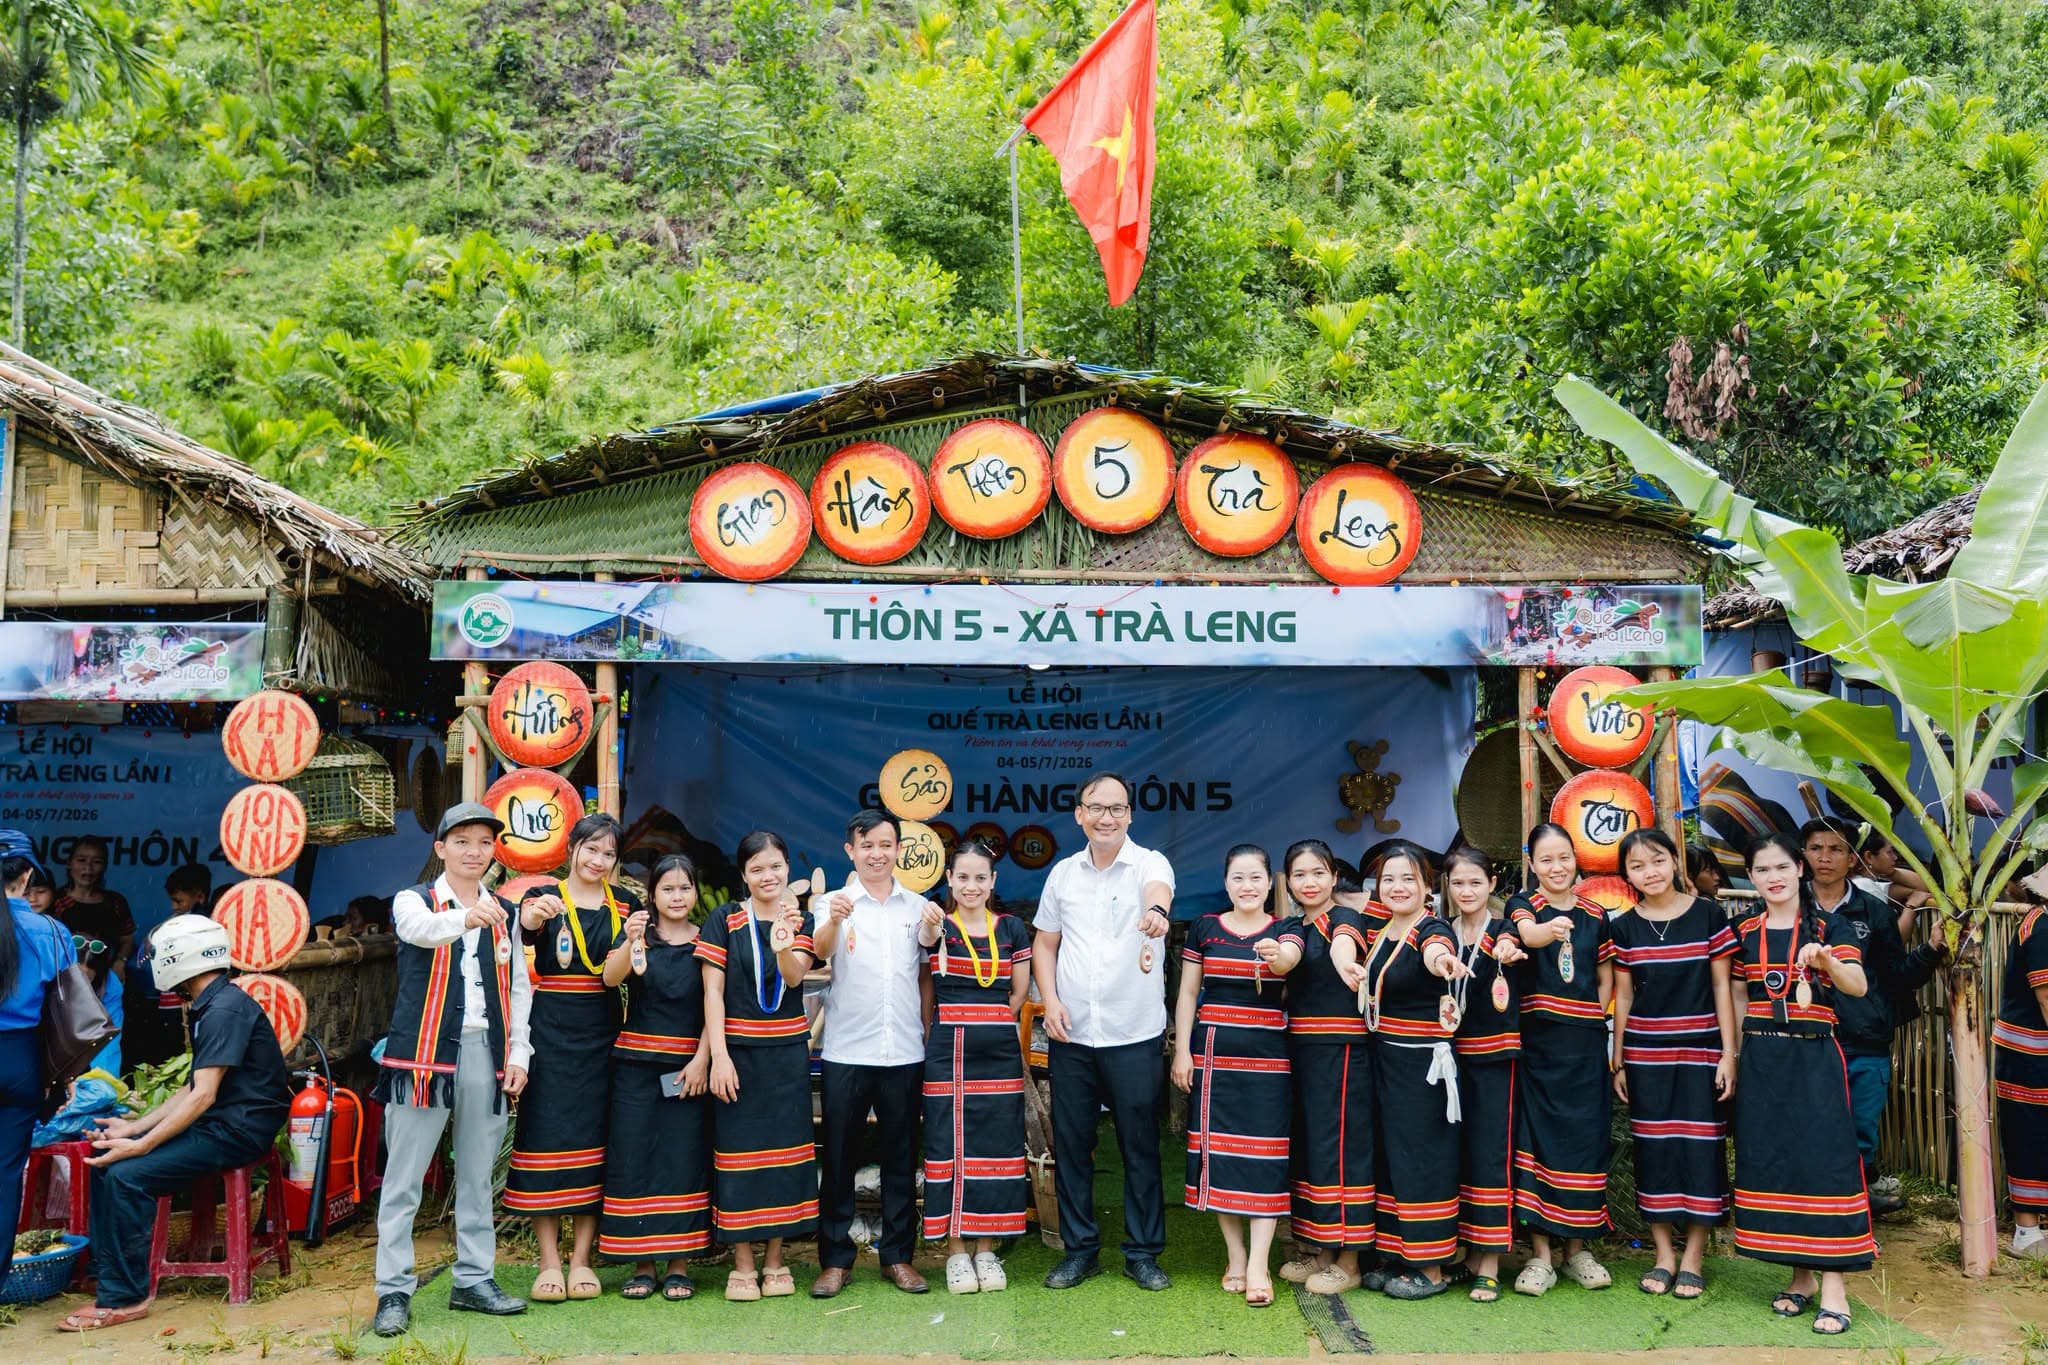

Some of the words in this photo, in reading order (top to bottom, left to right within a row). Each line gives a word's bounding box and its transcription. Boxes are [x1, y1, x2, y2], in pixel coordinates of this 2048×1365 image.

[826, 468, 914, 535] Hàng
[1094, 439, 1132, 500] 5
[1199, 458, 1282, 517] Trà
[1319, 488, 1402, 567] Leng
[823, 600, 942, 642] THÔN
[953, 608, 982, 641] 5
[1018, 602, 1078, 643] XÃ
[1085, 602, 1175, 643] TRÀ
[1184, 610, 1297, 643] LENG
[1624, 624, 1664, 643] Leng
[1008, 680, 1036, 704] LỄ
[1042, 683, 1082, 708] HỘI
[927, 705, 982, 730] QUẾ
[983, 709, 1031, 730] TRÀ
[1037, 712, 1099, 730] LENG
[1104, 706, 1150, 730] LẦN
[1156, 712, 1162, 730] I
[52, 732, 93, 759] HỘI
[0, 759, 39, 782] RÀ
[45, 764, 107, 783] LENG
[164, 764, 173, 784] I
[997, 756, 1093, 770] 04-05/7/2026
[967, 775, 1077, 813] HÀNG
[1206, 781, 1233, 811] 5
[2, 807, 99, 823] 04-05/7/2026
